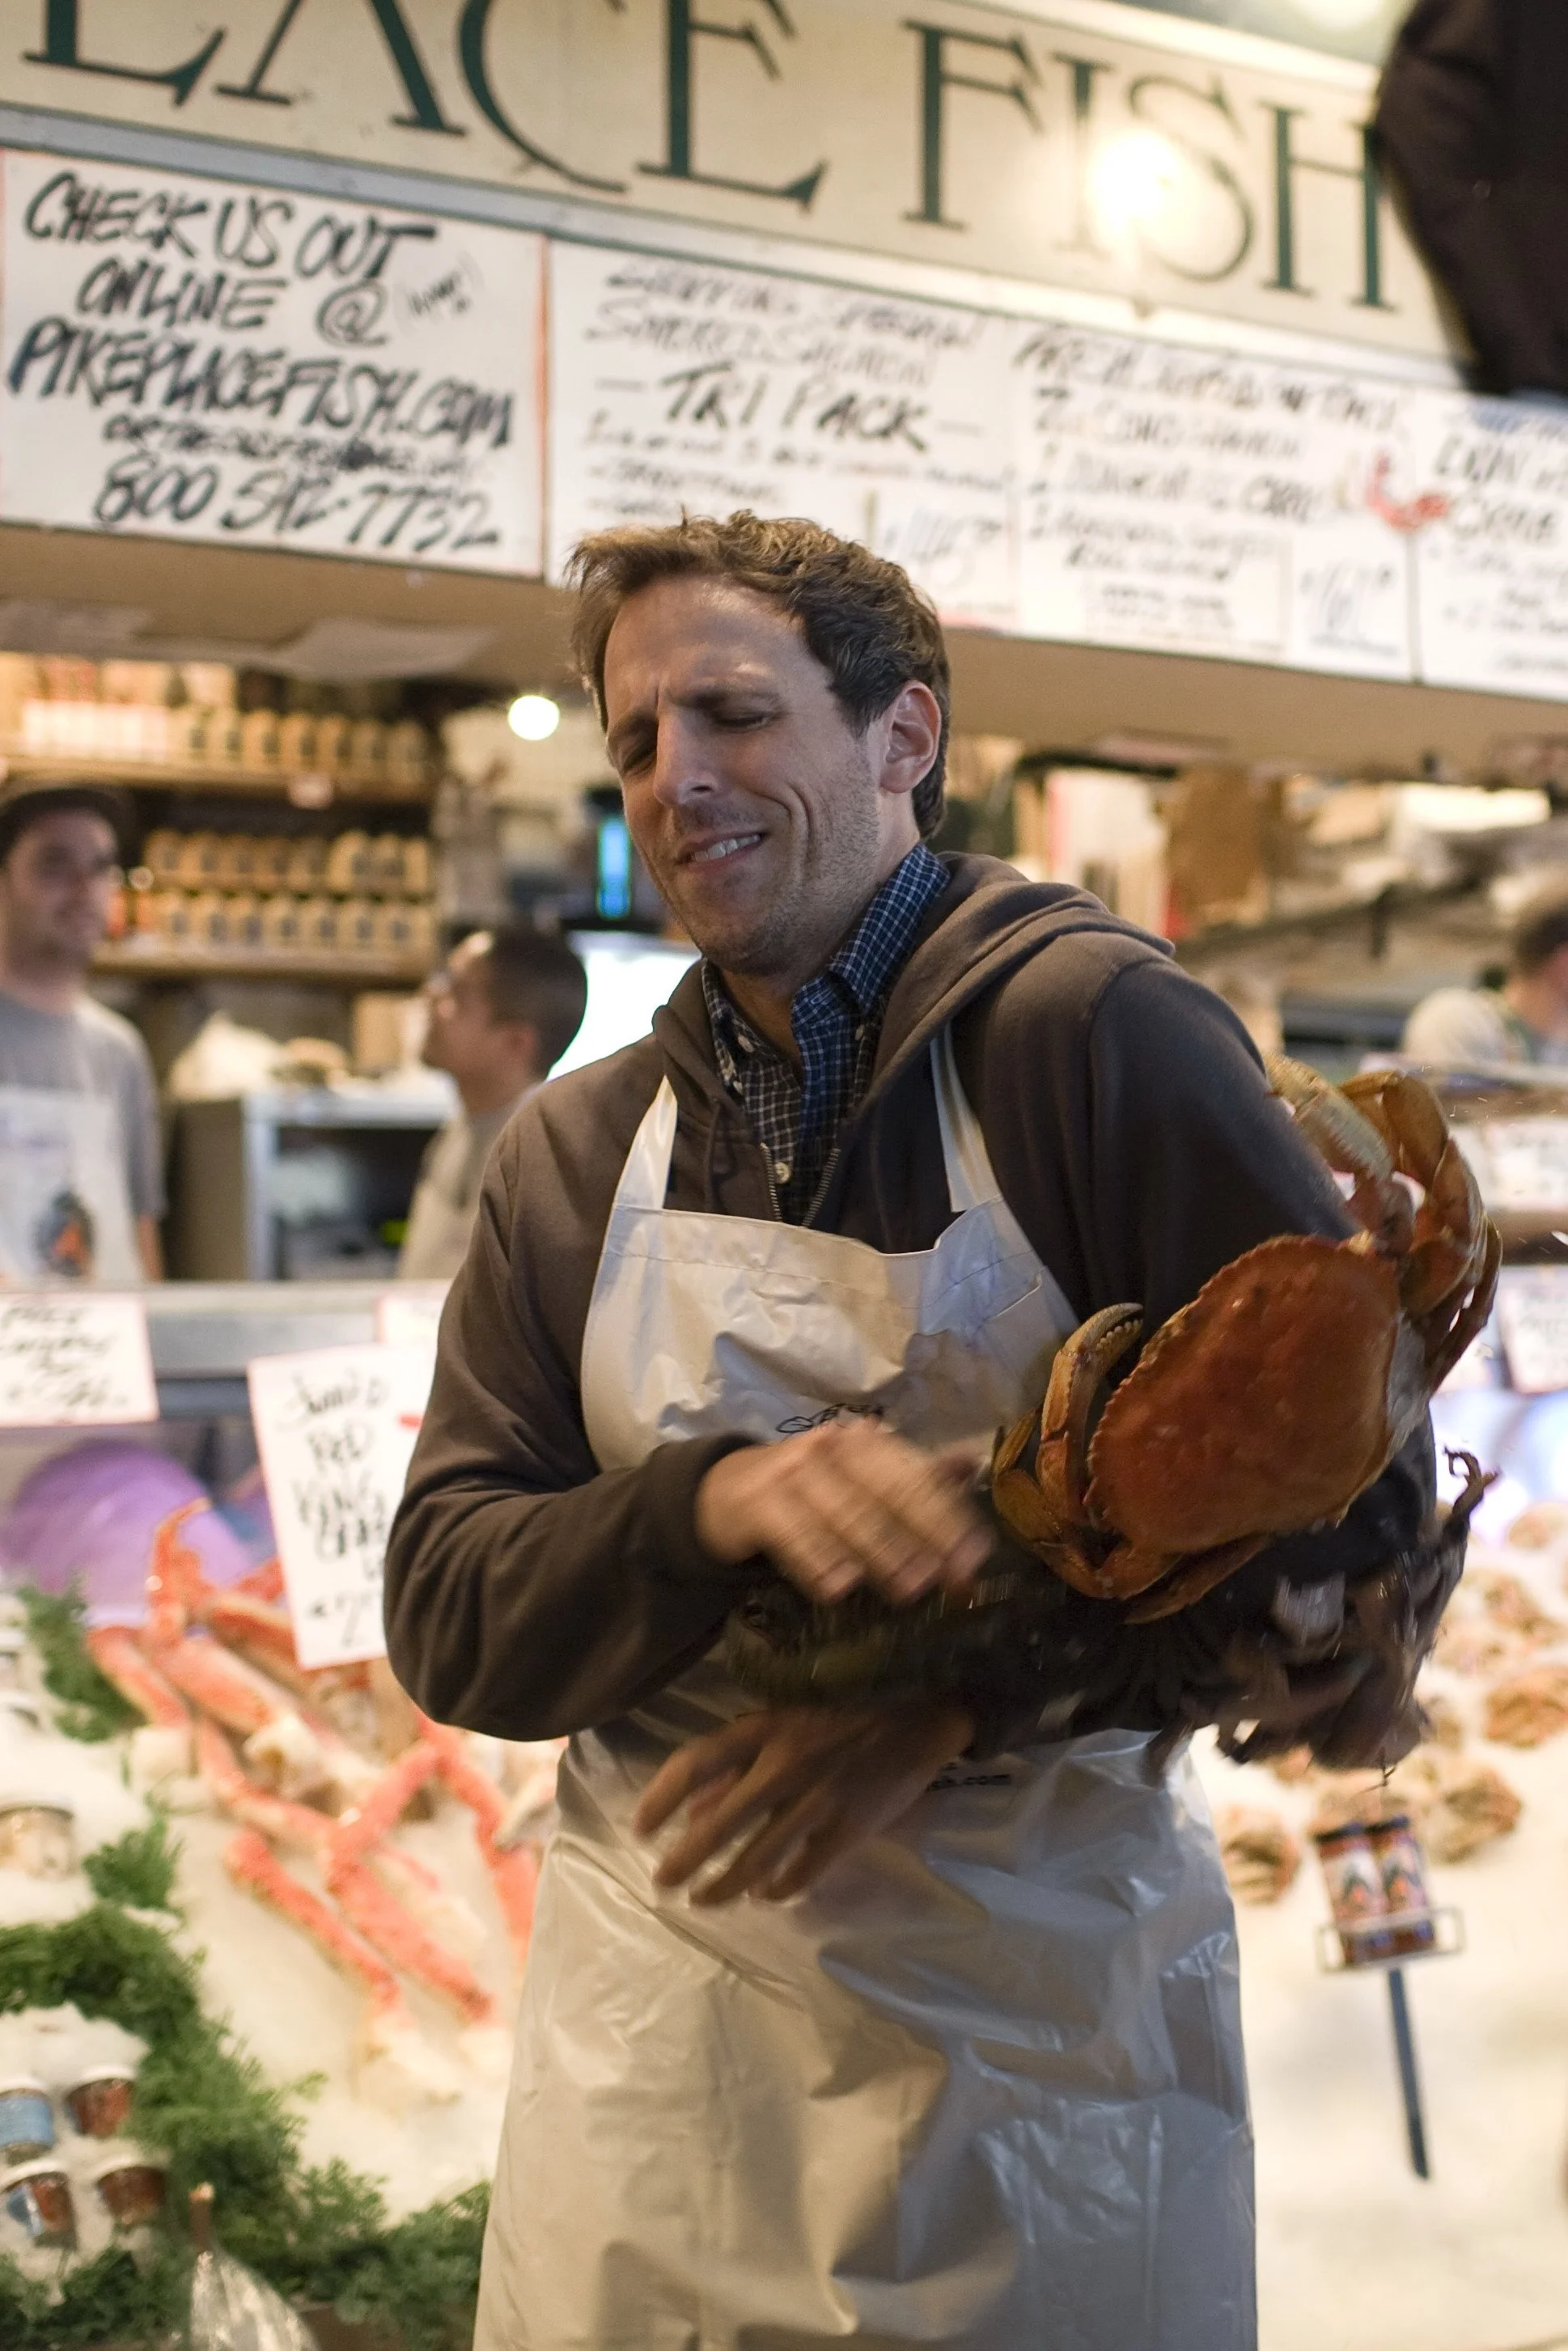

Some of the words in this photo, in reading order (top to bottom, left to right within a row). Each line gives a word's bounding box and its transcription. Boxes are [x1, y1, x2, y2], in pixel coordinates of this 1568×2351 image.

[901, 19, 1398, 314] FISH
[24, 171, 209, 259] CHECK
[214, 193, 295, 269] US
[295, 212, 438, 280] OUT
[75, 256, 288, 330] ONLINE
[6, 316, 518, 450] PIKEPLACEFISH.COM
[781, 374, 929, 453] PACK
[93, 453, 220, 524] 800
